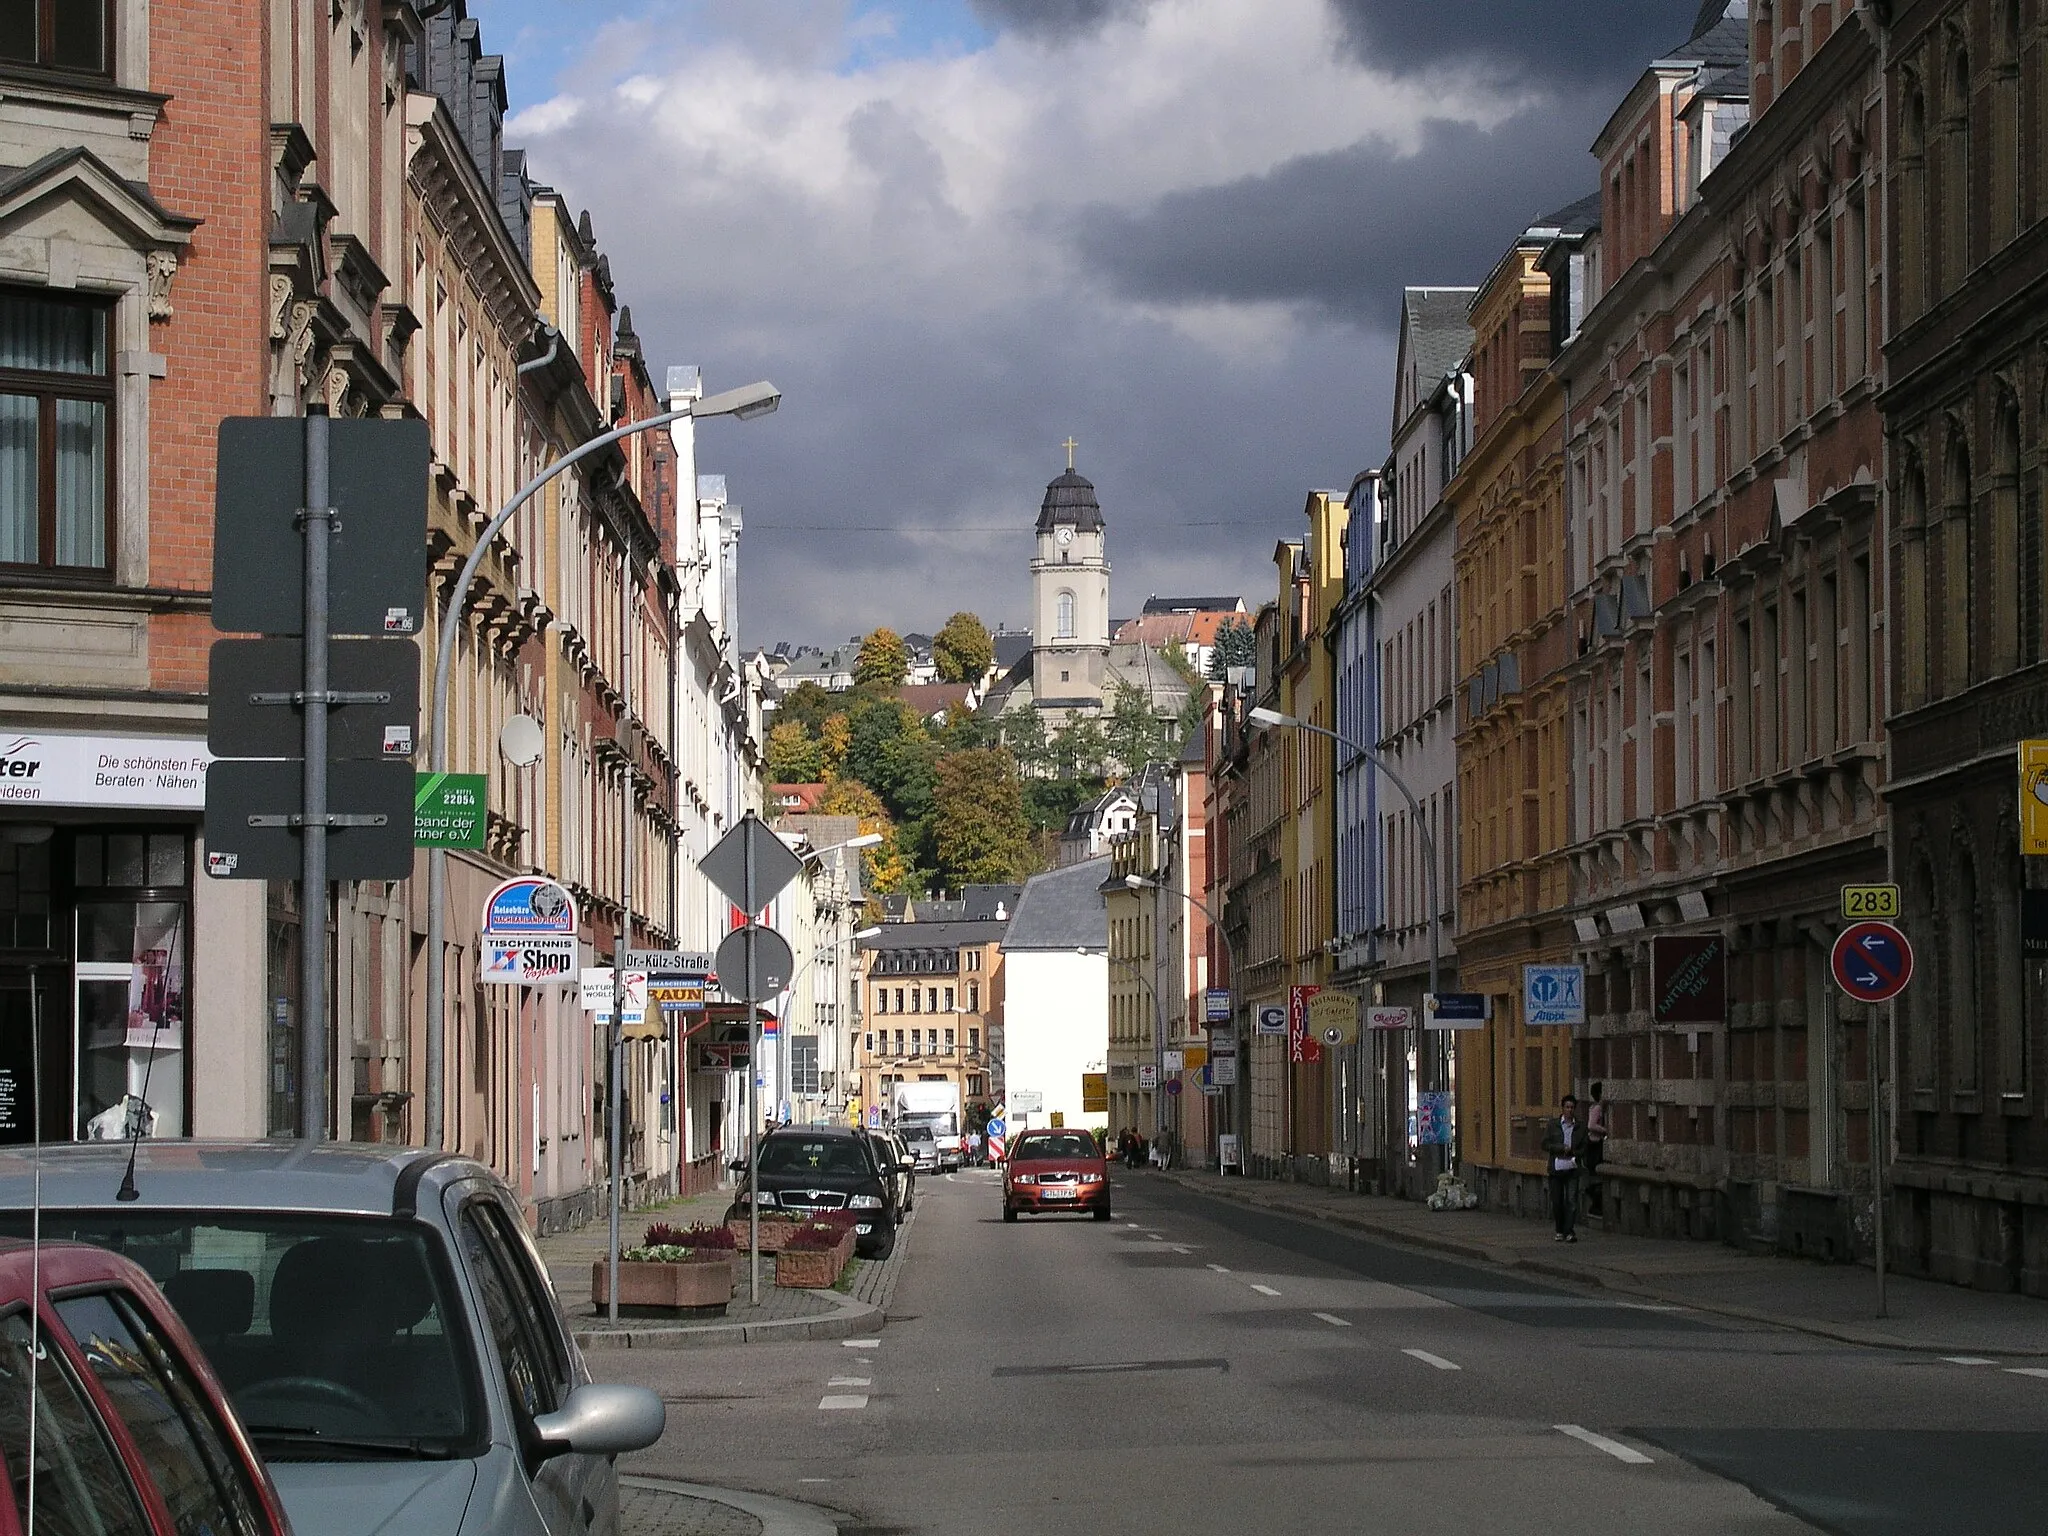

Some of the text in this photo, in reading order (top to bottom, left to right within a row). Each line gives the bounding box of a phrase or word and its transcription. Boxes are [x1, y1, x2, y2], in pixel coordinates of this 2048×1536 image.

[98, 755, 119, 769] Die
[123, 756, 187, 771] schönsten
[95, 772, 197, 789] Beraten Nähen
[0, 784, 41, 799] ideen
[443, 794, 475, 805] 22054
[452, 817, 475, 829] der
[448, 829, 470, 841] e.V.
[1850, 891, 1891, 912] 283
[494, 906, 530, 914] Reisebüro
[488, 940, 573, 948] TISCHTENNIS
[523, 949, 572, 973] Shop
[626, 953, 711, 970] Dr.-Külz-Straße
[1310, 995, 1355, 1008] RESTAURANT
[1293, 986, 1303, 1062] KALINKA
